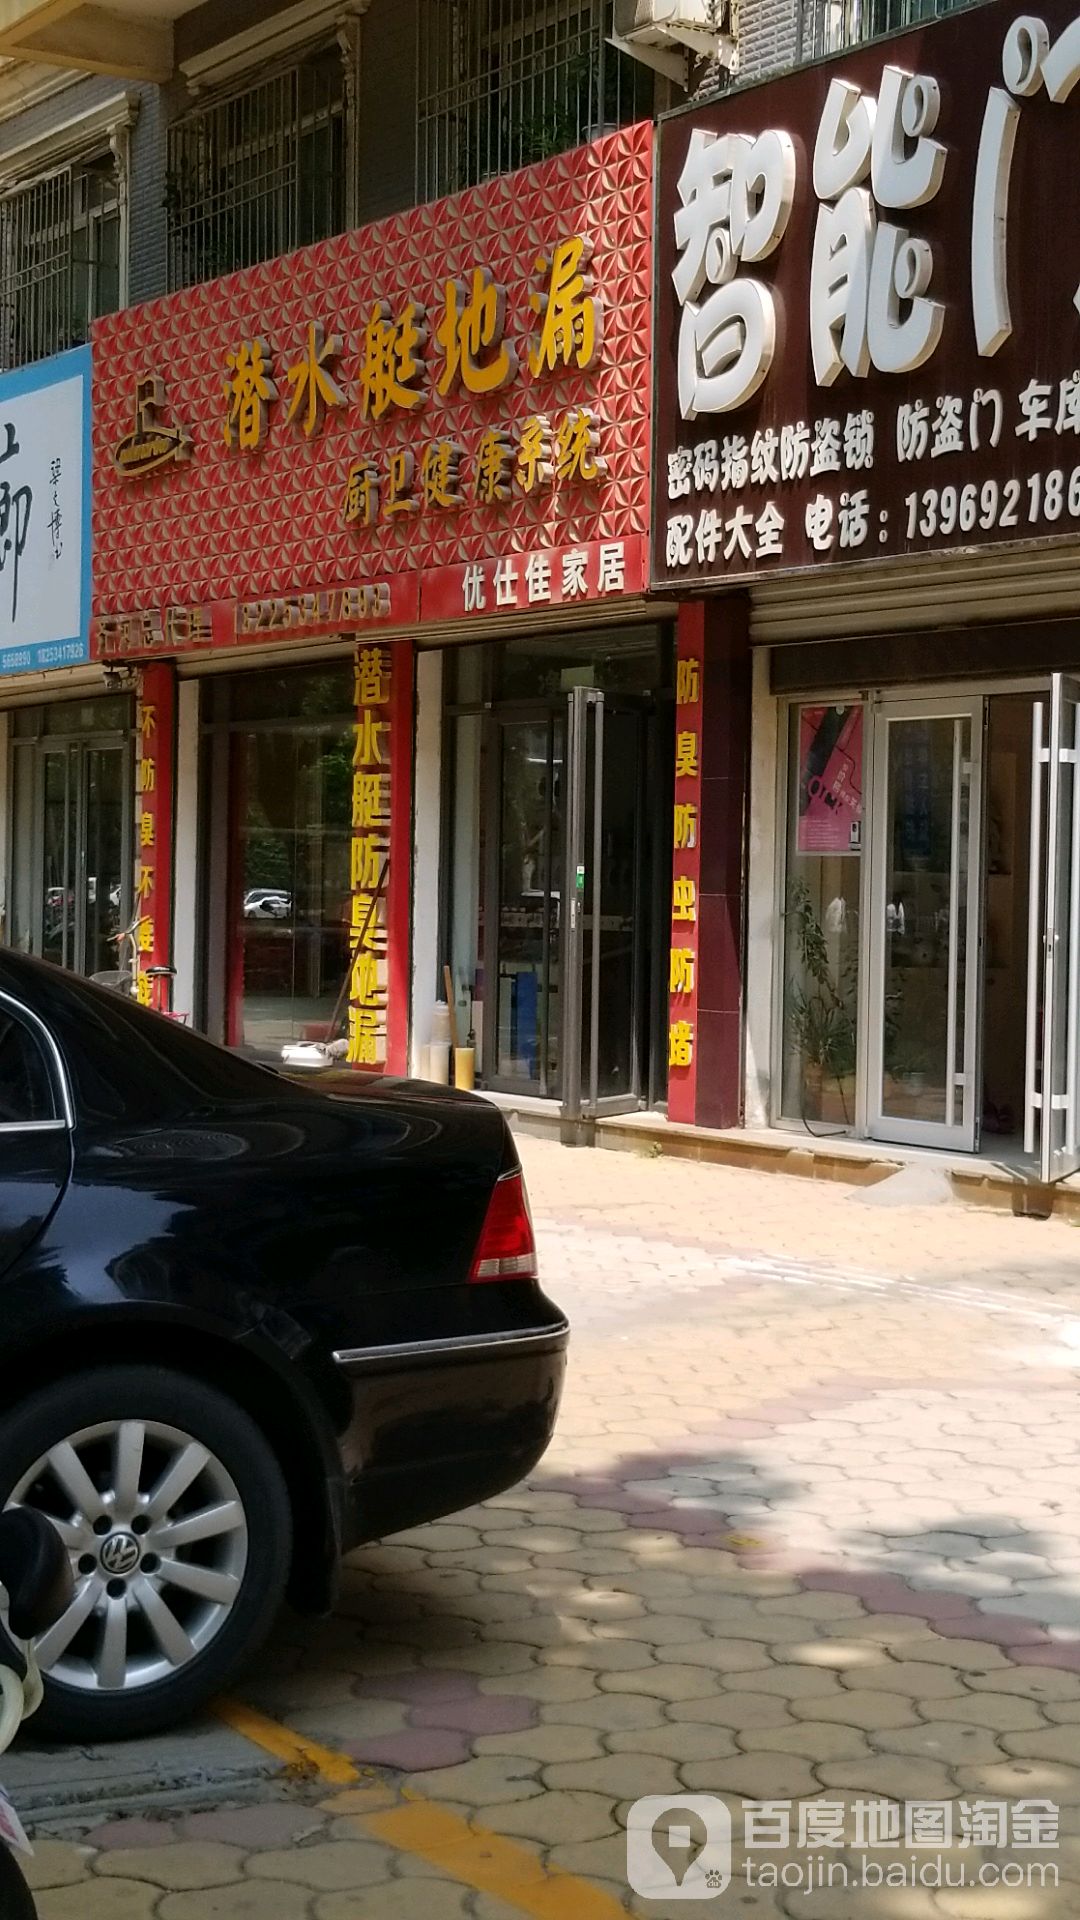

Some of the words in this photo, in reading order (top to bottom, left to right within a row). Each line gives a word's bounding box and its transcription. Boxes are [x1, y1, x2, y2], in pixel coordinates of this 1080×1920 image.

[223, 235, 603, 450] 潜水艇地漏
[343, 407, 607, 526] 厨卫健康系统
[667, 410, 875, 499] 密码指纹防盗锁
[896, 388, 1003, 463] 防盗门
[463, 541, 626, 612] 优仕佳家居
[666, 500, 785, 567] 配件大全
[346, 647, 391, 1066] 潜水艇防臭地漏
[668, 658, 699, 1068] 防臭防虫防堵
